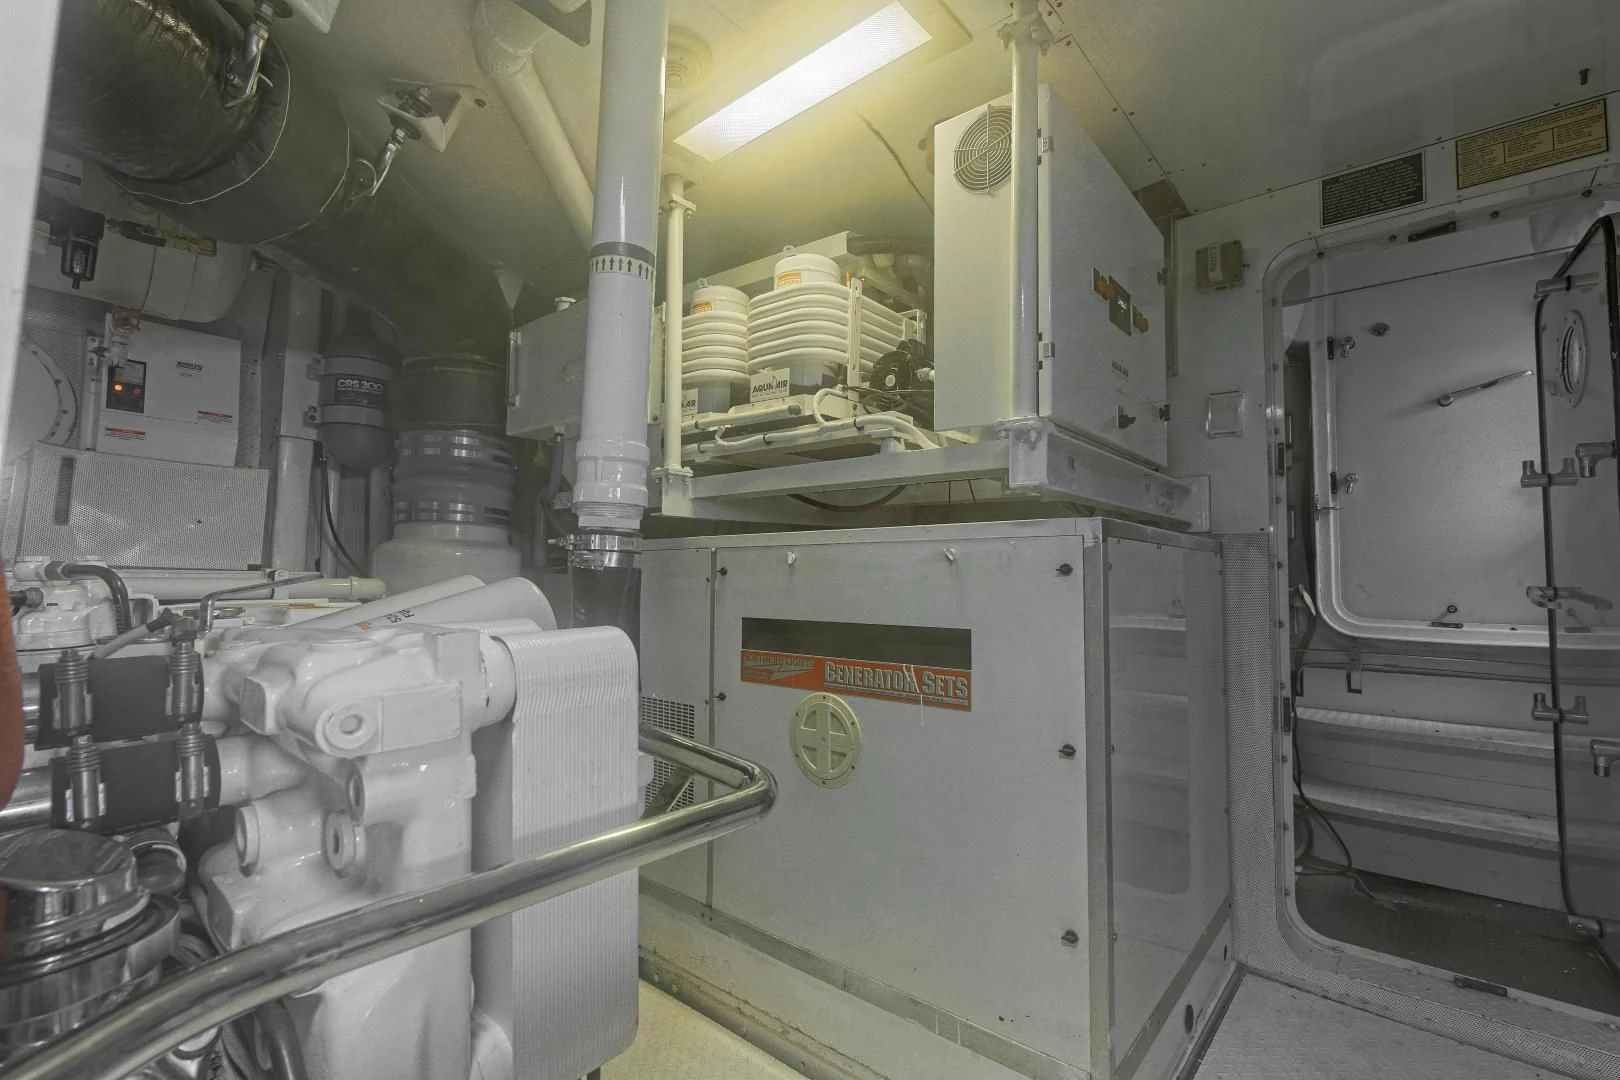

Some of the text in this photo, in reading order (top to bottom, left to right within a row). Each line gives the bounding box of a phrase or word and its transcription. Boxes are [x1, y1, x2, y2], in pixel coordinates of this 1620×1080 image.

[338, 379, 384, 391] CRS 300
[824, 661, 916, 692] GENERATOR
[921, 670, 968, 698] SETS
